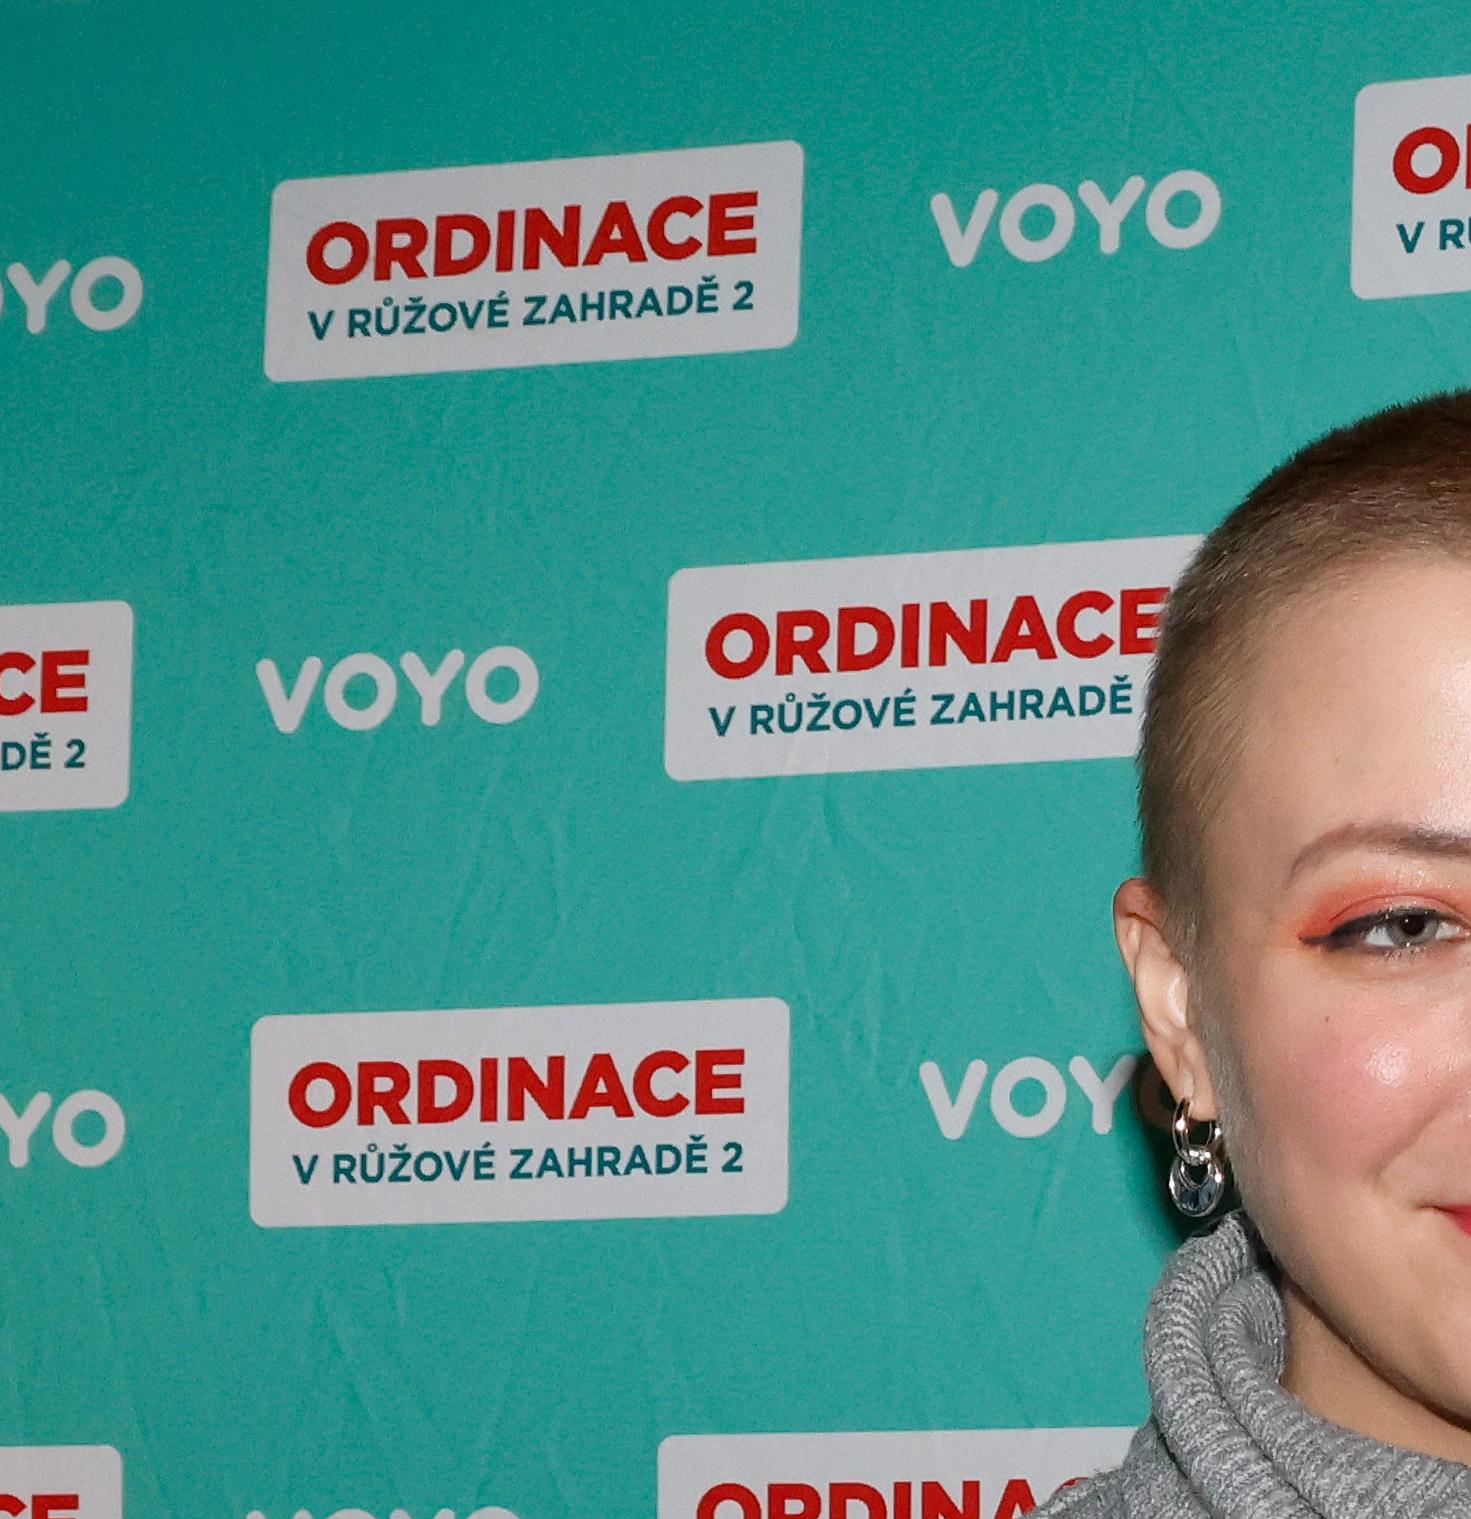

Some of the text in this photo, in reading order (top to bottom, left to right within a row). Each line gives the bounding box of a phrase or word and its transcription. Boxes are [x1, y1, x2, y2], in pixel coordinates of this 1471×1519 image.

[307, 192, 757, 284] ORDINACE
[930, 170, 1222, 267] VOYO
[1396, 220, 1426, 255] V
[706, 588, 1168, 679] ORDINACE
[256, 645, 540, 734] VOYO
[64, 737, 87, 769] 2
[289, 1049, 744, 1128] ORDINACE
